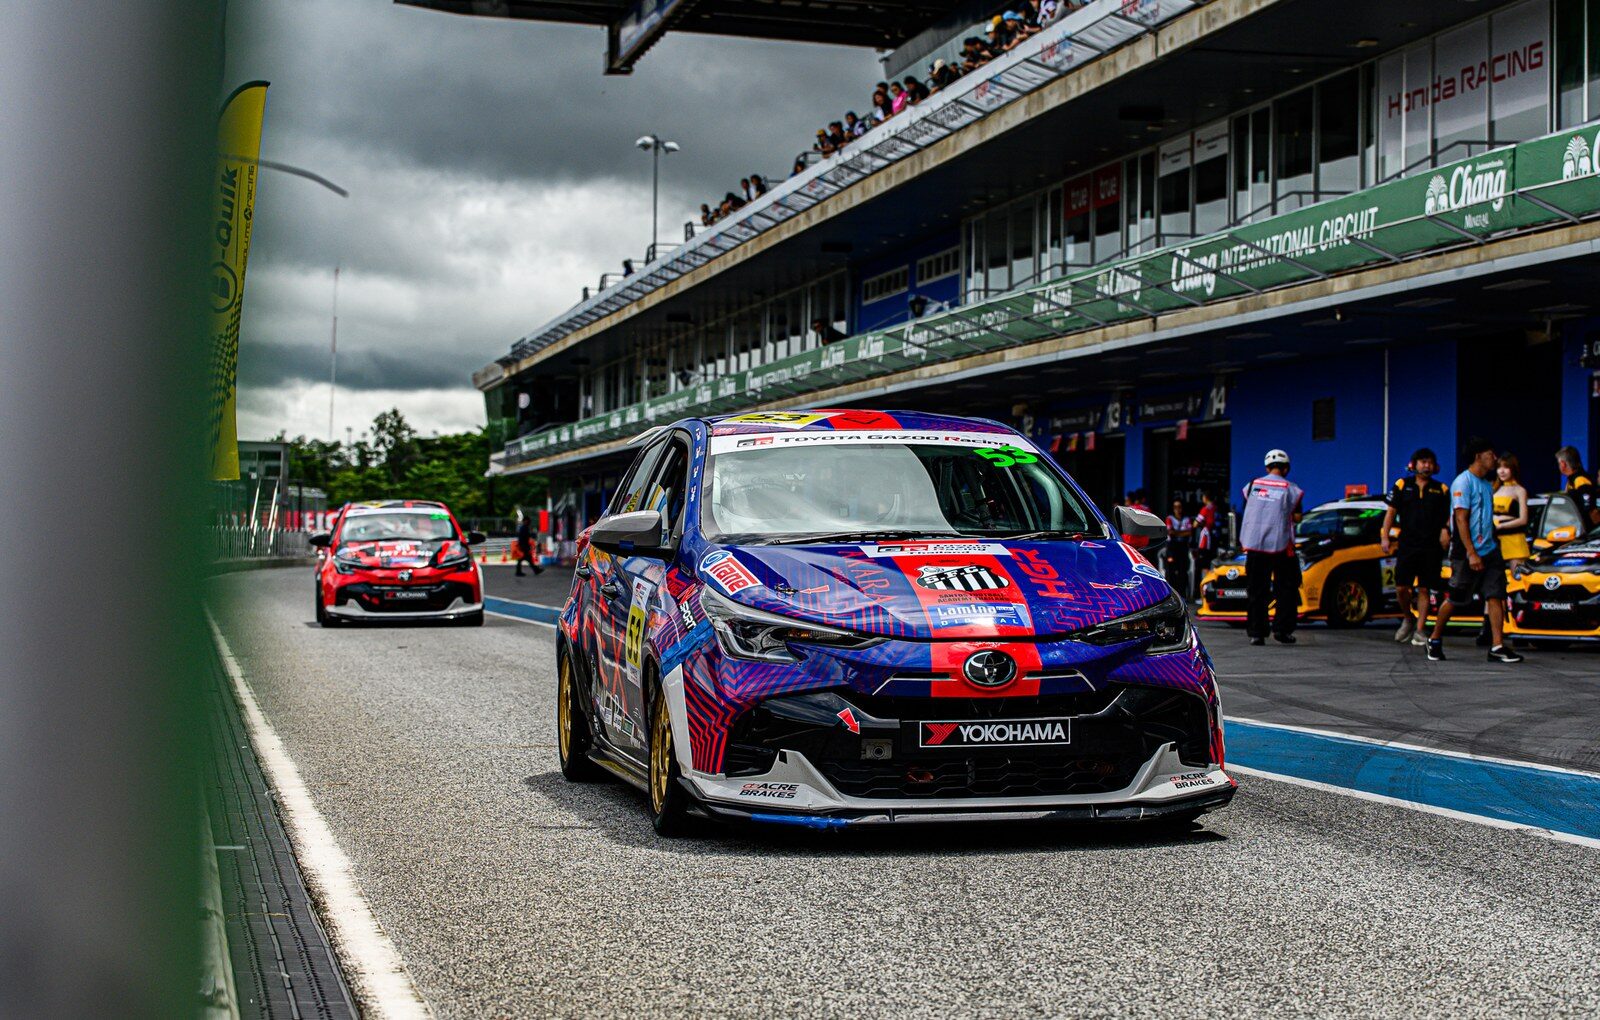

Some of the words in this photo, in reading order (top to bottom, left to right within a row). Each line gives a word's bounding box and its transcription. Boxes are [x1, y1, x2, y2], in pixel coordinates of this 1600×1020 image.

[1388, 75, 1456, 118] Honda
[1461, 41, 1543, 93] RACING
[1099, 175, 1118, 200] true
[1449, 164, 1507, 213] Chang
[1171, 248, 1218, 297] Chang
[1219, 225, 1316, 275] INTERNATIONAL
[1319, 206, 1379, 251] CIRCUIT
[1210, 386, 1226, 416] 14
[743, 413, 810, 421] 53
[780, 434, 861, 443] TOYOTA
[867, 434, 939, 442] GAZOO
[945, 436, 1010, 446] Racing
[973, 445, 1038, 467] 53
[709, 557, 759, 593] Trane
[1006, 548, 1075, 600] HGR
[941, 618, 1019, 626] DIGAL
[959, 722, 1066, 742] YOKOHAMA
[758, 783, 800, 791] ACRE
[1175, 778, 1215, 789] BRAKES
[1181, 772, 1208, 781] ACRE
[739, 789, 797, 799] BRAKES
